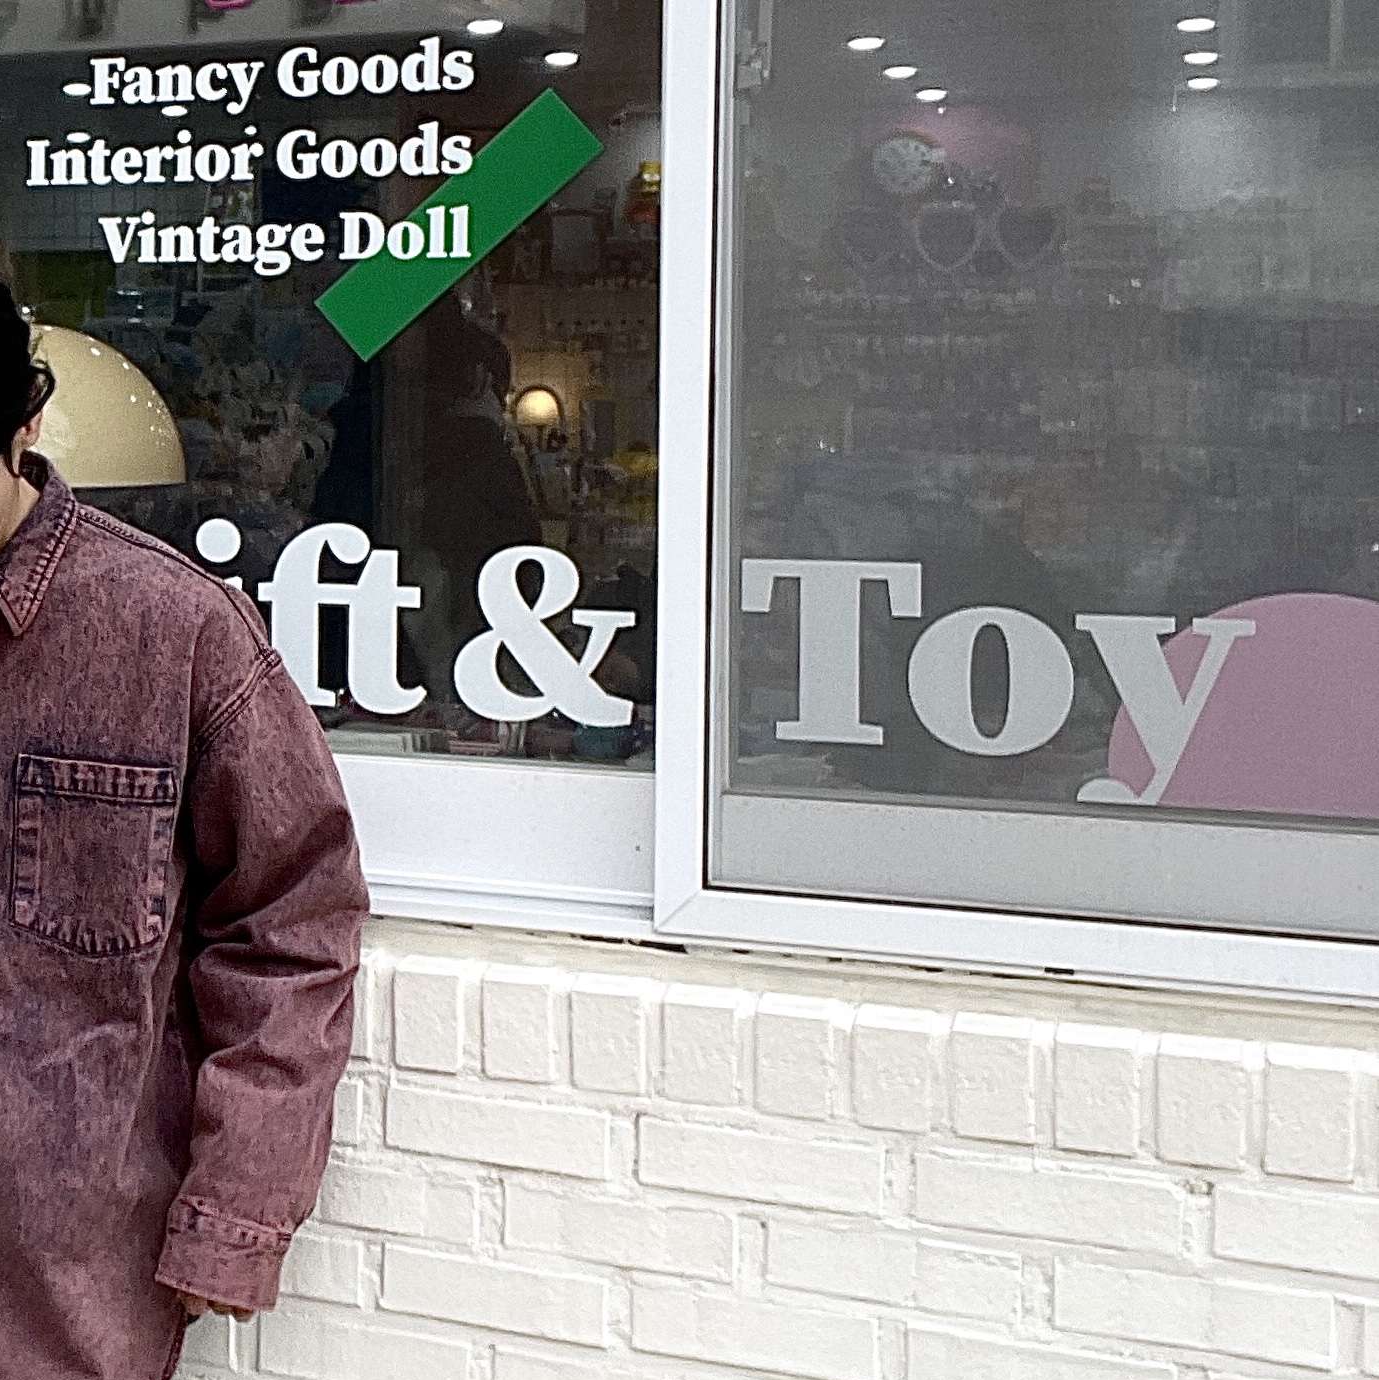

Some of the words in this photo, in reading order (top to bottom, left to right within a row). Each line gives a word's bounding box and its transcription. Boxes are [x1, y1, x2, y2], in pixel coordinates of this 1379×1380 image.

[89, 58, 265, 115] Fancy
[277, 37, 474, 98] Goods
[26, 129, 264, 187] Interior
[276, 121, 473, 180] Goods
[98, 211, 325, 276] Vintage
[338, 204, 472, 260] Doll
[195, 518, 427, 715] ft
[453, 545, 636, 727] &
[741, 558, 1257, 806] Toy
